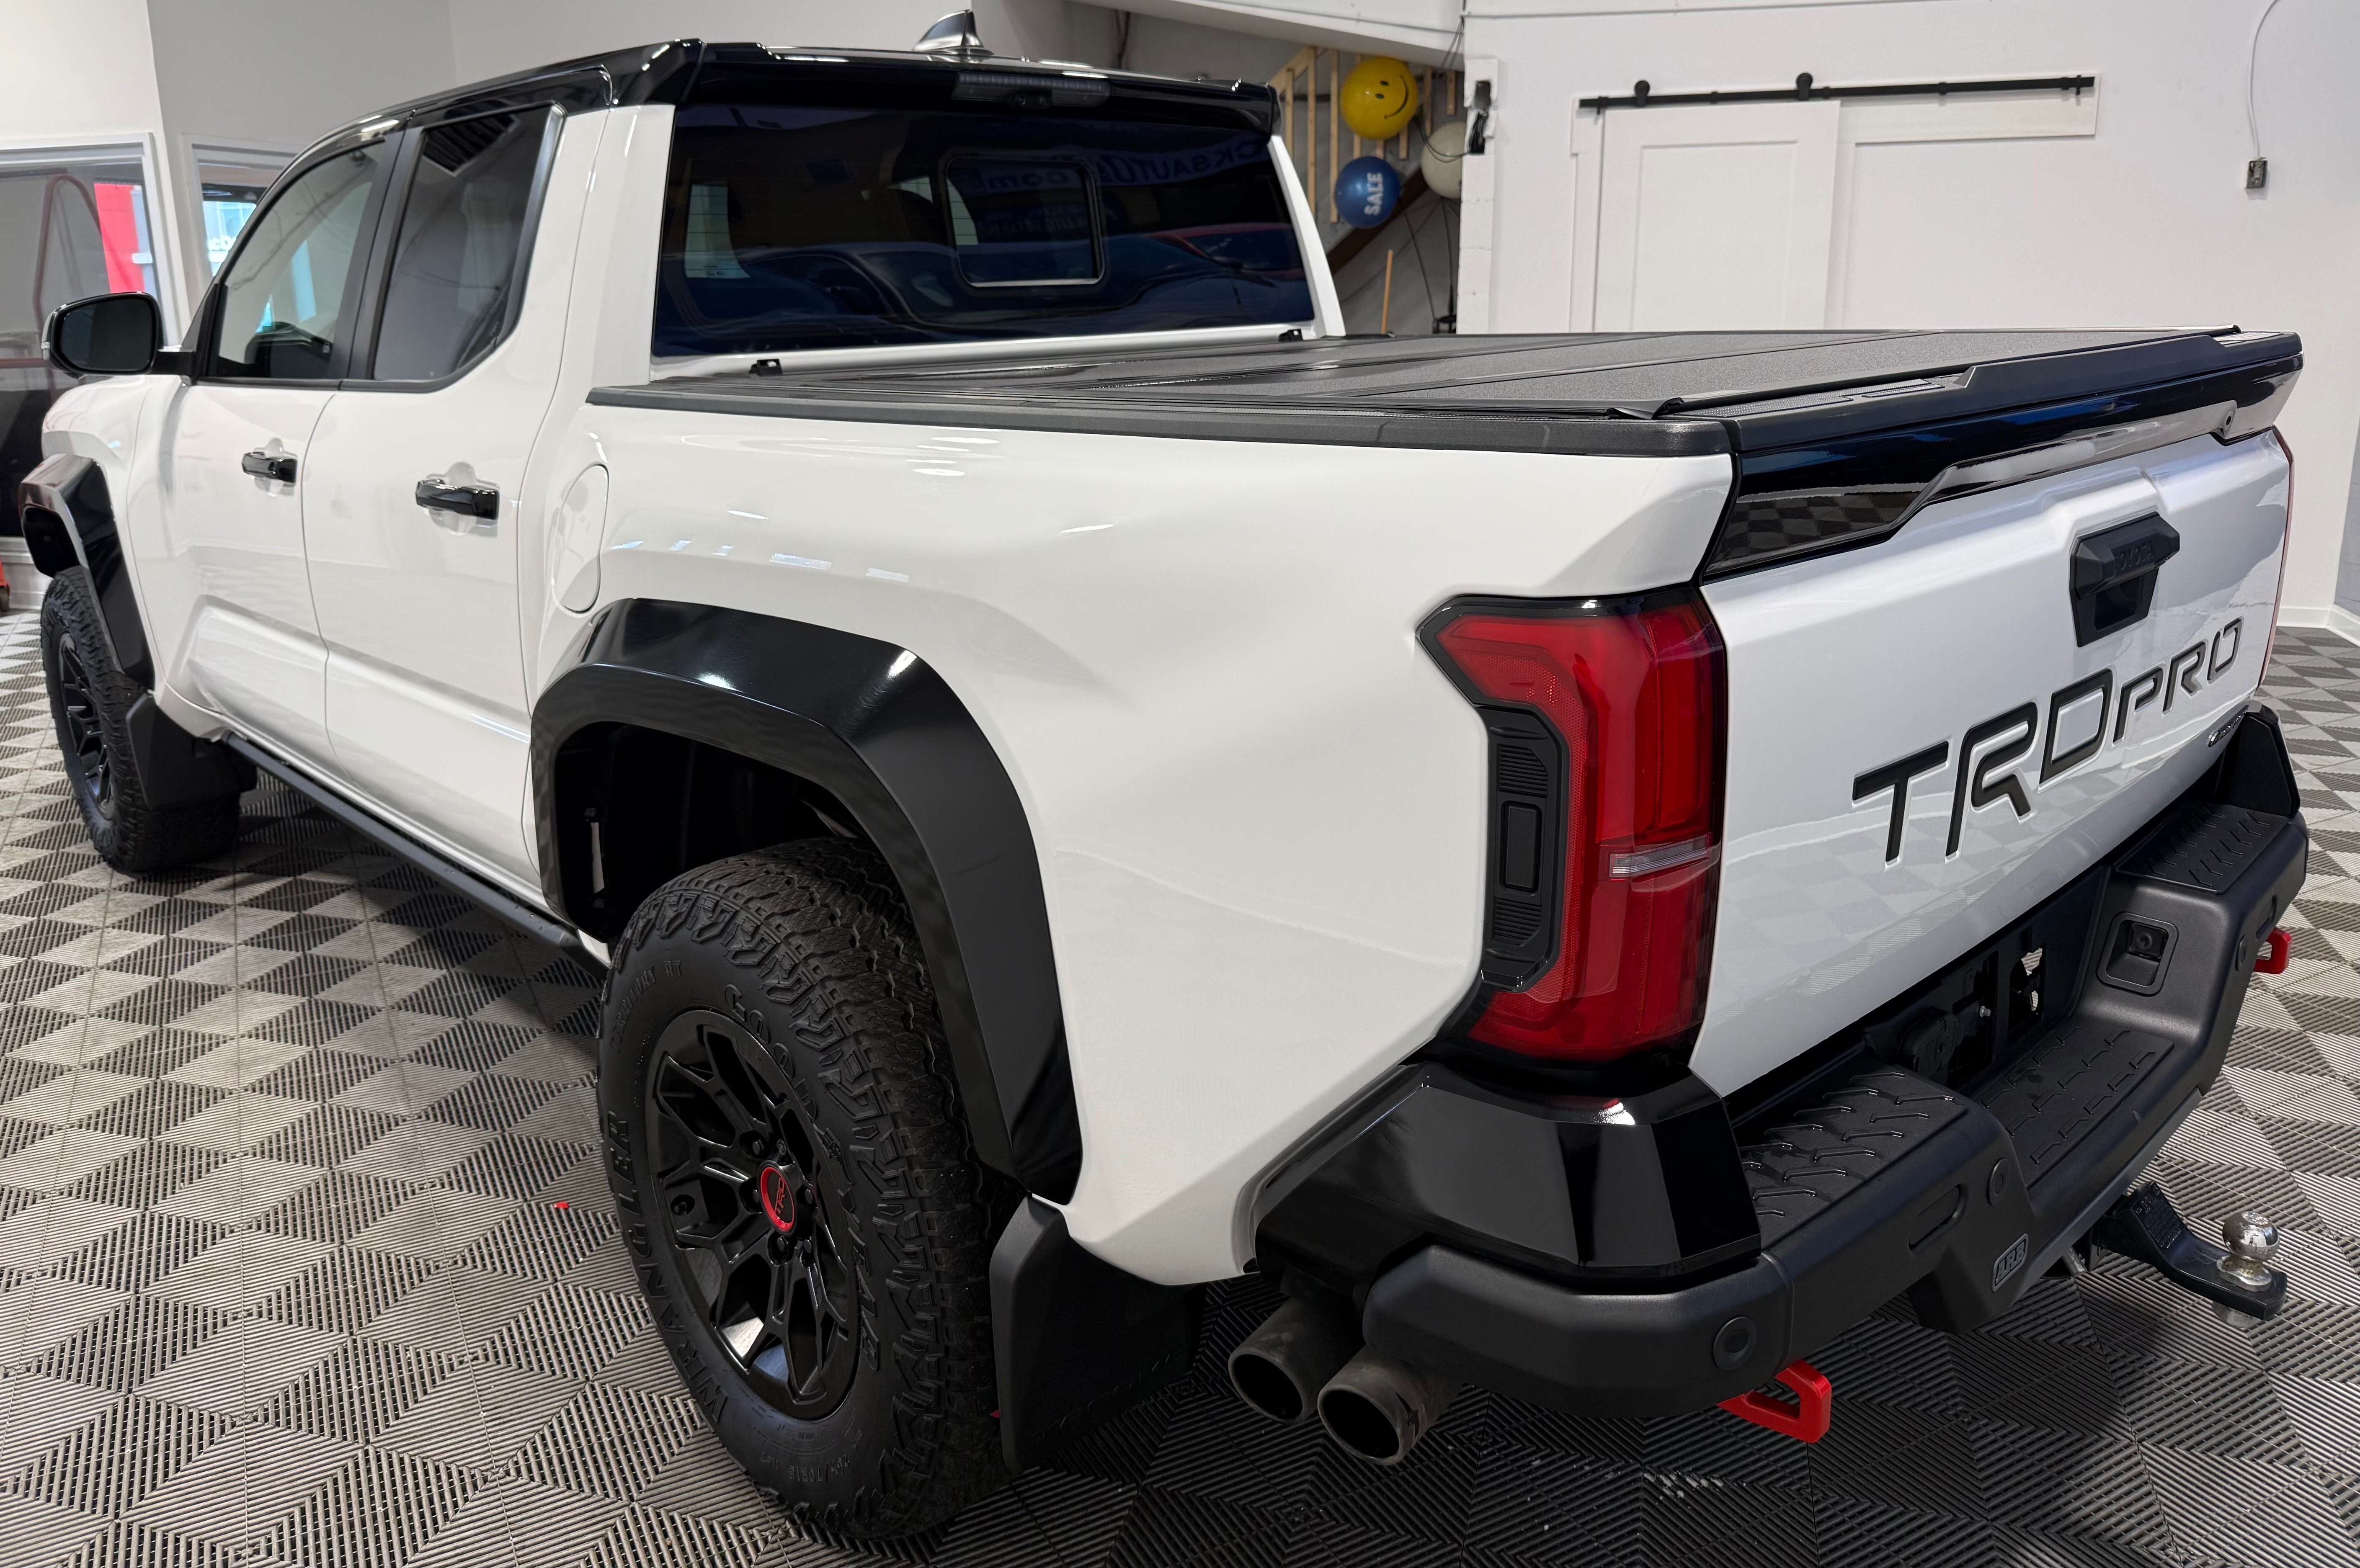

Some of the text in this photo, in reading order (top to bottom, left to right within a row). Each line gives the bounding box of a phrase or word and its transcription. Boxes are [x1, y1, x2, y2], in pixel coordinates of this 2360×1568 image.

[1364, 171, 1384, 216] SALE
[1853, 617, 2244, 863] TRD PRO
[775, 1177, 786, 1214] TRD
[607, 1110, 728, 1424] WRANGLER
[1995, 1239, 2025, 1287] ARB
[788, 1452, 851, 1483] 265/70R18
